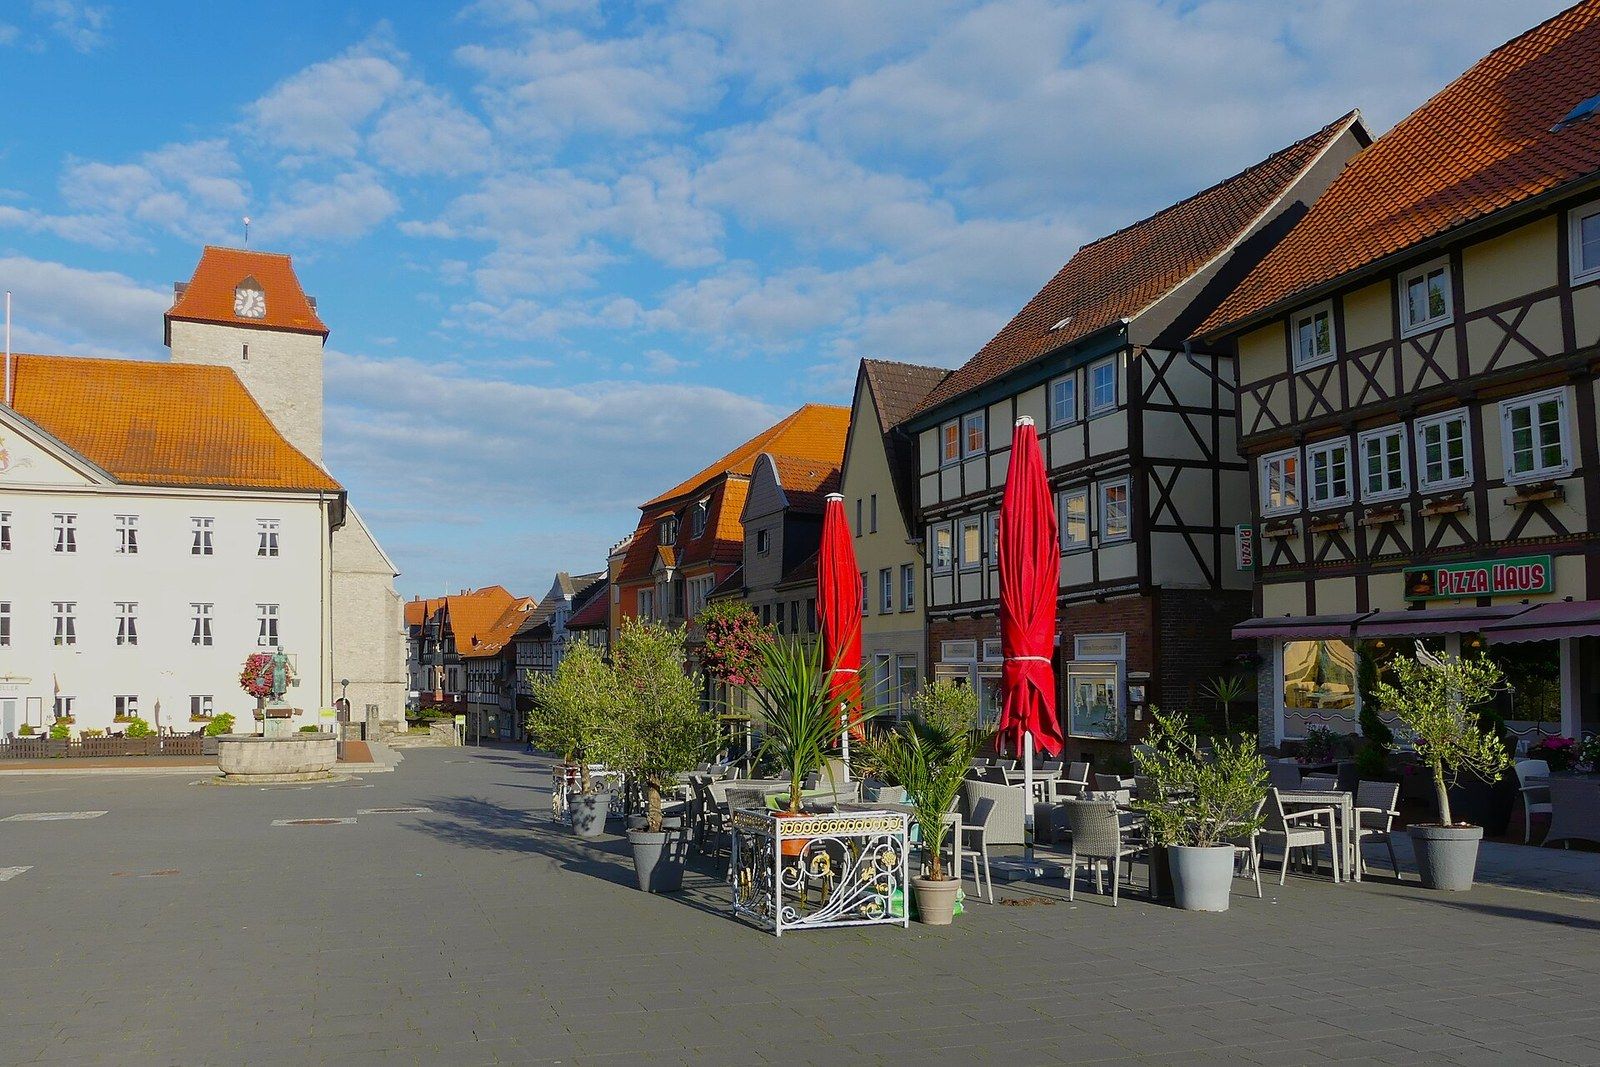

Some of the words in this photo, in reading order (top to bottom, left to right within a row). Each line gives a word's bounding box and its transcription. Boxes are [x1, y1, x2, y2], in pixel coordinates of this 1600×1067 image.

[1240, 529, 1252, 565] PIZZA
[1438, 569, 1489, 595] PIZZA
[1493, 564, 1544, 591] HAUS
